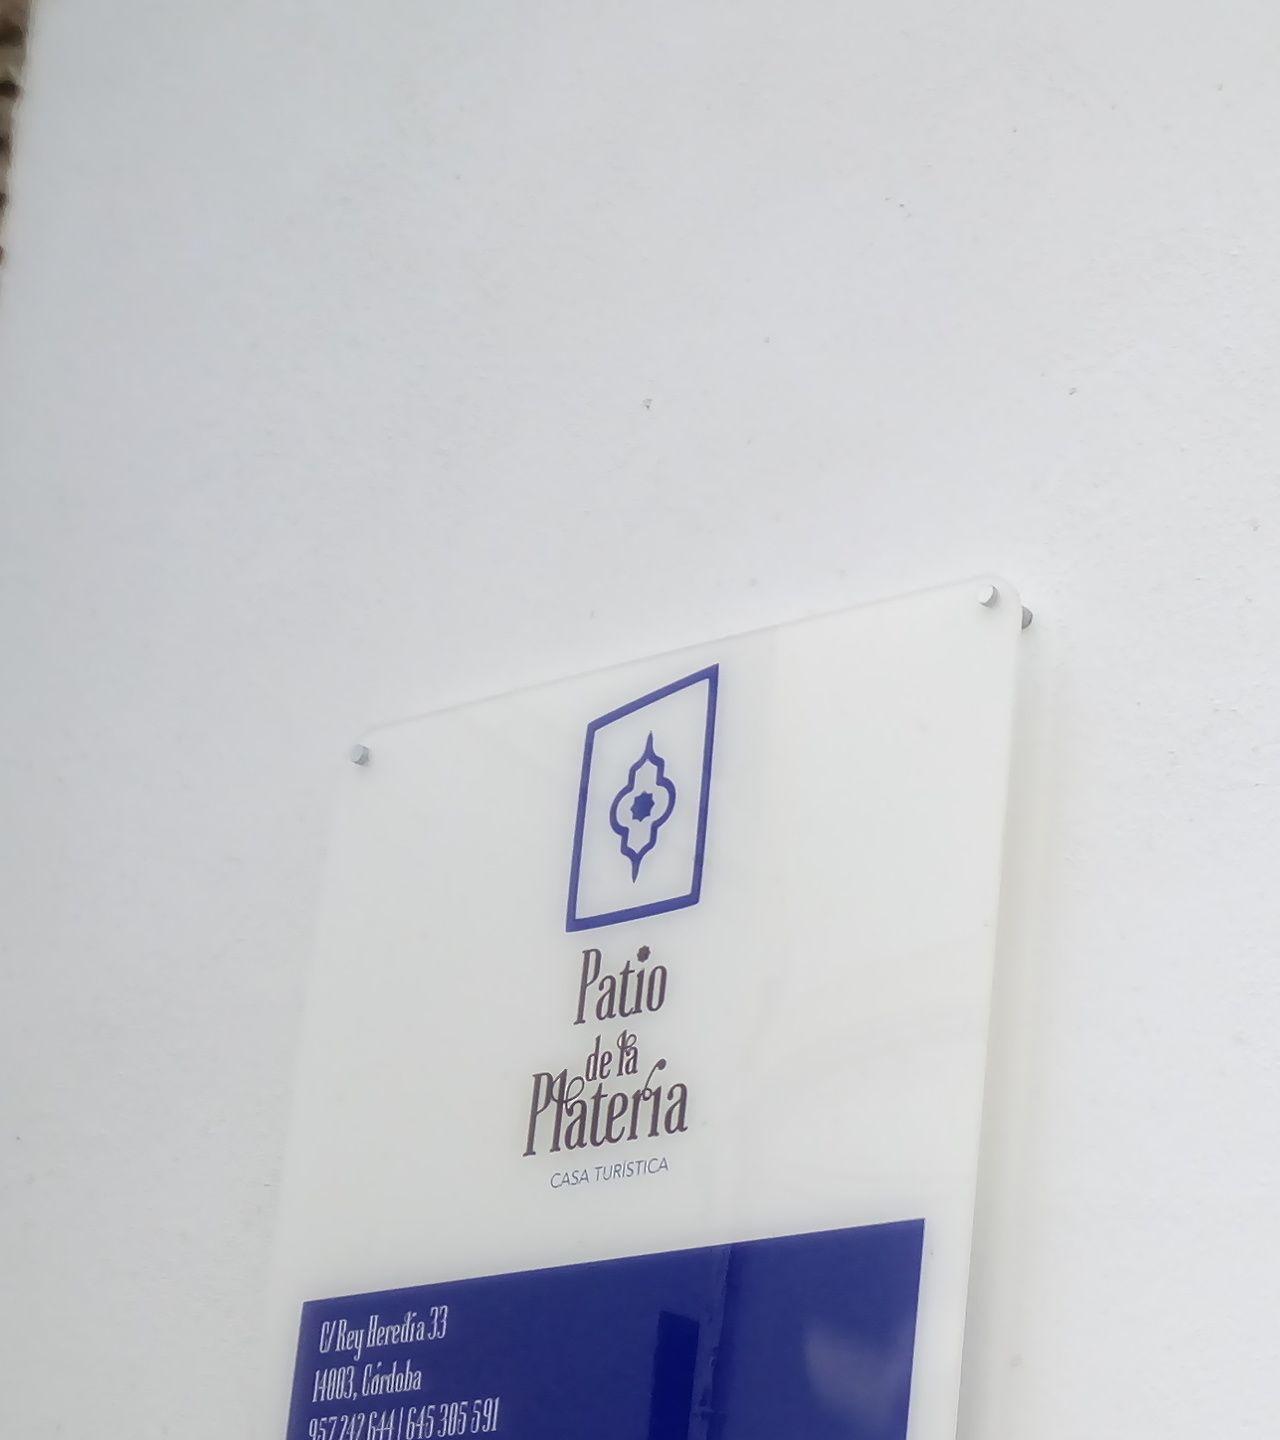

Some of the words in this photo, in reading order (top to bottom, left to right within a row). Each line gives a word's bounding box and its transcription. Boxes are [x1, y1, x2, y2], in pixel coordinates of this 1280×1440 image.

[573, 945, 668, 1026] Patio
[585, 1034, 613, 1082] de
[616, 1029, 639, 1077] la
[522, 1058, 689, 1157] Platería
[550, 1169, 590, 1189] CASA
[594, 1157, 669, 1182] TURÍSTICA
[335, 1318, 364, 1362] Rey
[366, 1312, 425, 1348] Heredia
[427, 1304, 449, 1340] 33
[312, 1366, 358, 1403] 14003,
[362, 1359, 422, 1397] Córdoba
[406, 1404, 436, 1440] 645
[437, 1401, 468, 1437] 305
[471, 1396, 500, 1434] 591
